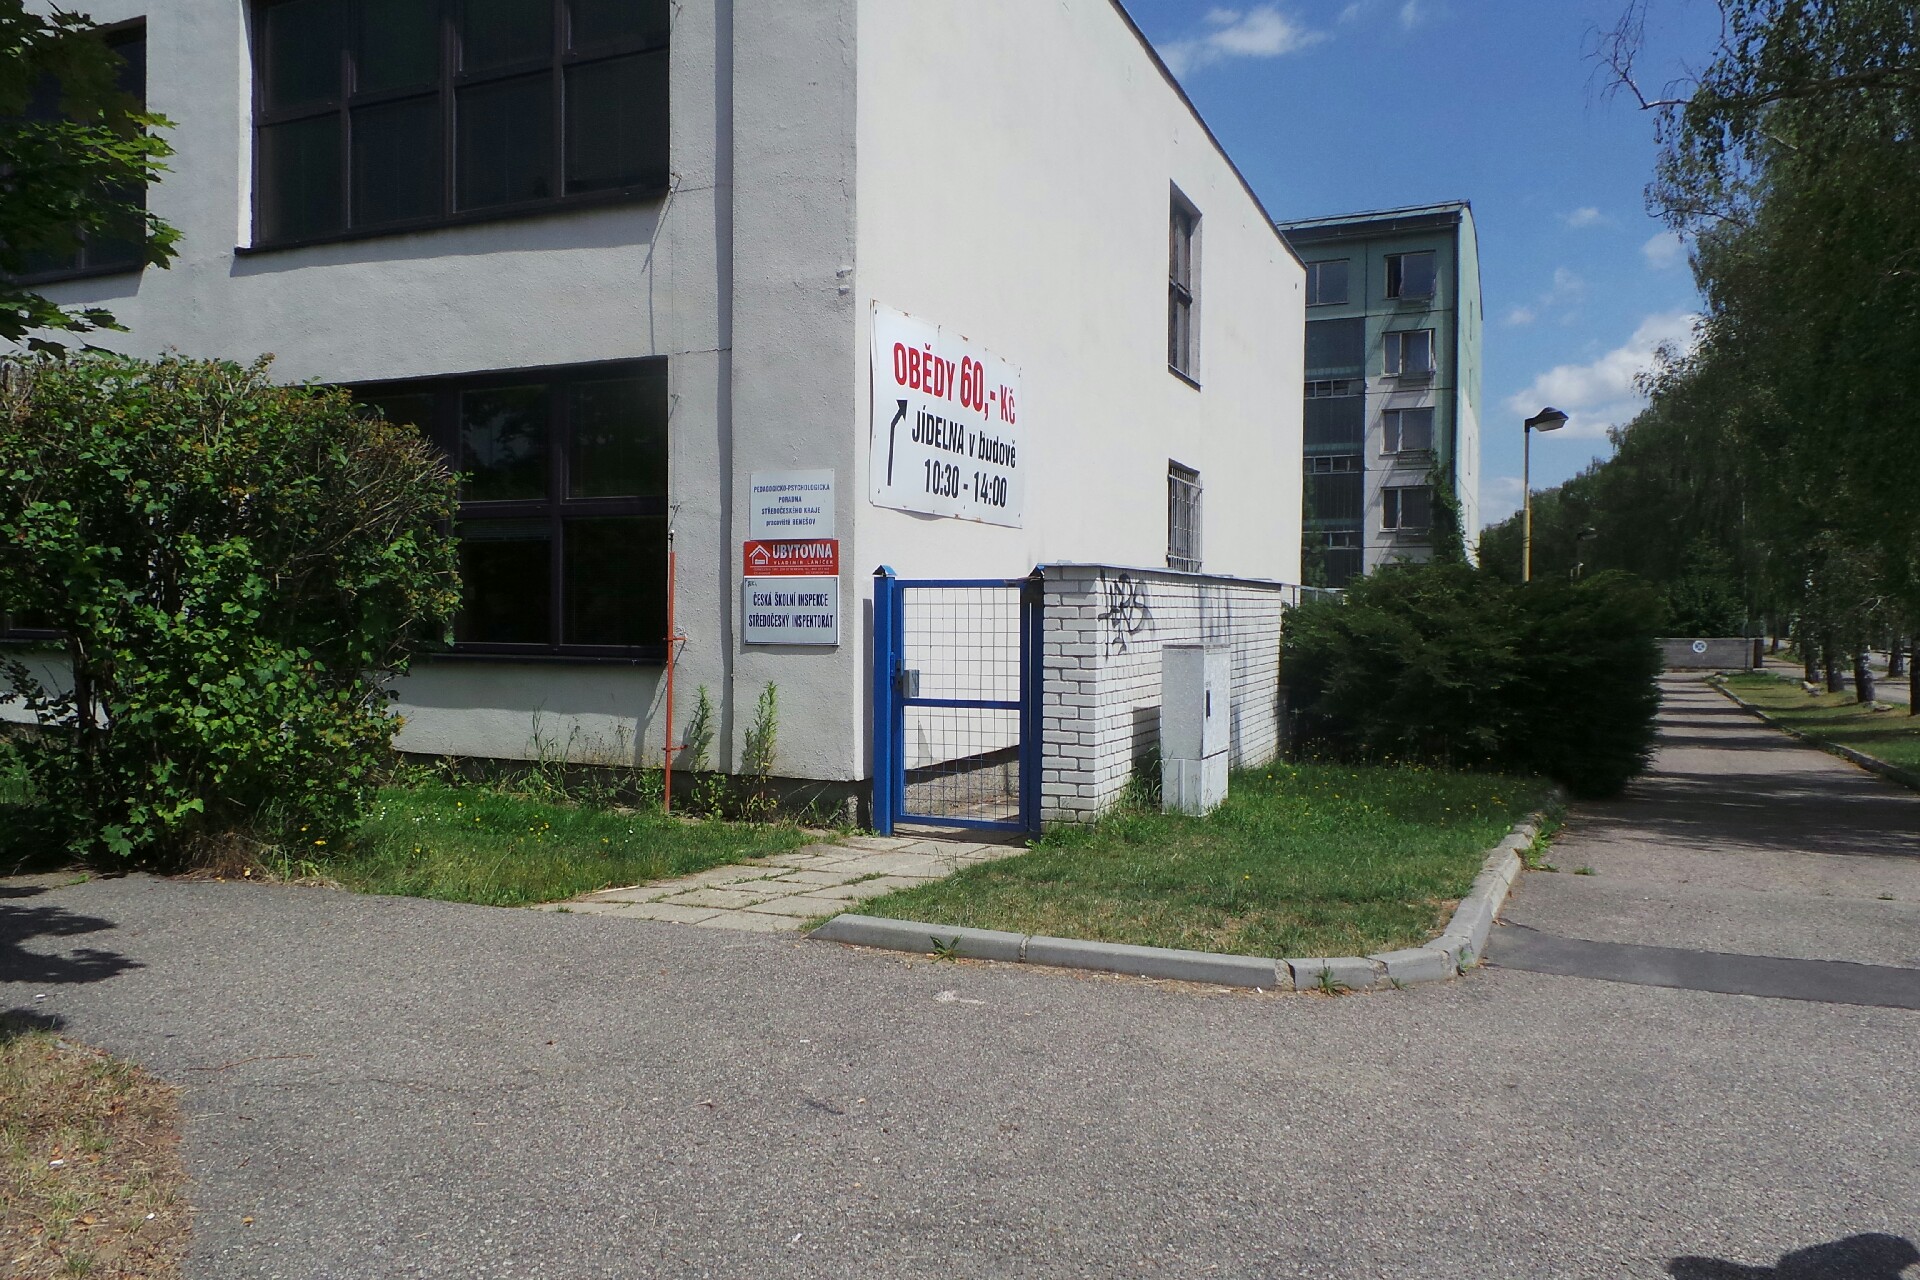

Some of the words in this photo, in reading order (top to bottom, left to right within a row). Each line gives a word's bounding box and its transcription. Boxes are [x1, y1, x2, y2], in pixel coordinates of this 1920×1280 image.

[893, 342, 956, 401] OBĚDY
[960, 355, 996, 421] 60,-
[911, 404, 965, 455] JÍDELNA
[969, 433, 976, 458] v
[978, 430, 1016, 469] budově
[924, 459, 960, 499] 10:30
[974, 471, 1008, 508] 14:00
[792, 517, 816, 525] BENEŠOV
[772, 543, 833, 559] UBYTOVNA
[753, 592, 772, 606] ČESKÁ
[774, 592, 796, 606] ŠKOLNÍ
[798, 593, 828, 606] INSPEKCE
[748, 613, 790, 628] STŘEDOČESKÝ
[791, 613, 834, 628] INSPEKTORÁT
